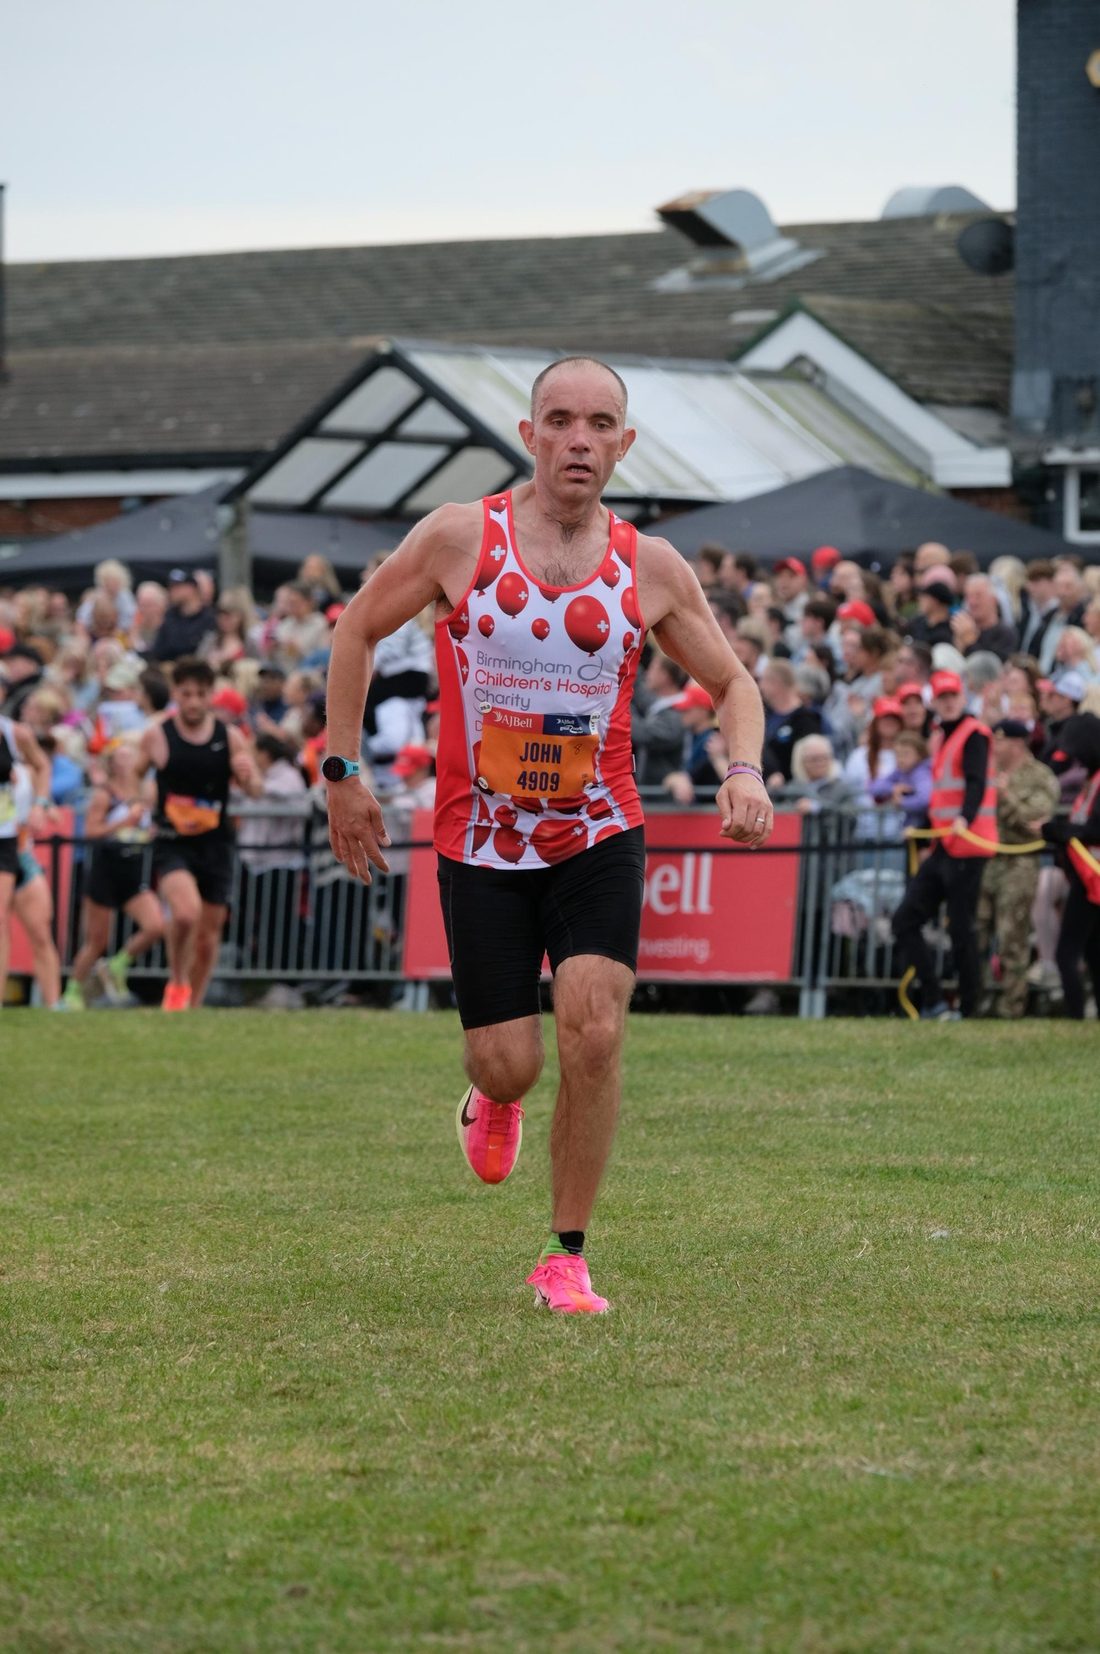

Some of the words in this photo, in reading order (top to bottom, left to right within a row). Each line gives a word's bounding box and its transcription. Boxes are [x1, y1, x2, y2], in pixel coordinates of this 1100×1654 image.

[476, 651, 572, 675] Birmingham
[474, 669, 552, 692] Children's
[557, 679, 612, 698] Hospital
[474, 688, 531, 711] Charity
[519, 742, 562, 764] JOHN
[516, 771, 560, 792] 4909
[643, 852, 713, 915] ell
[639, 935, 711, 964] nvesting
